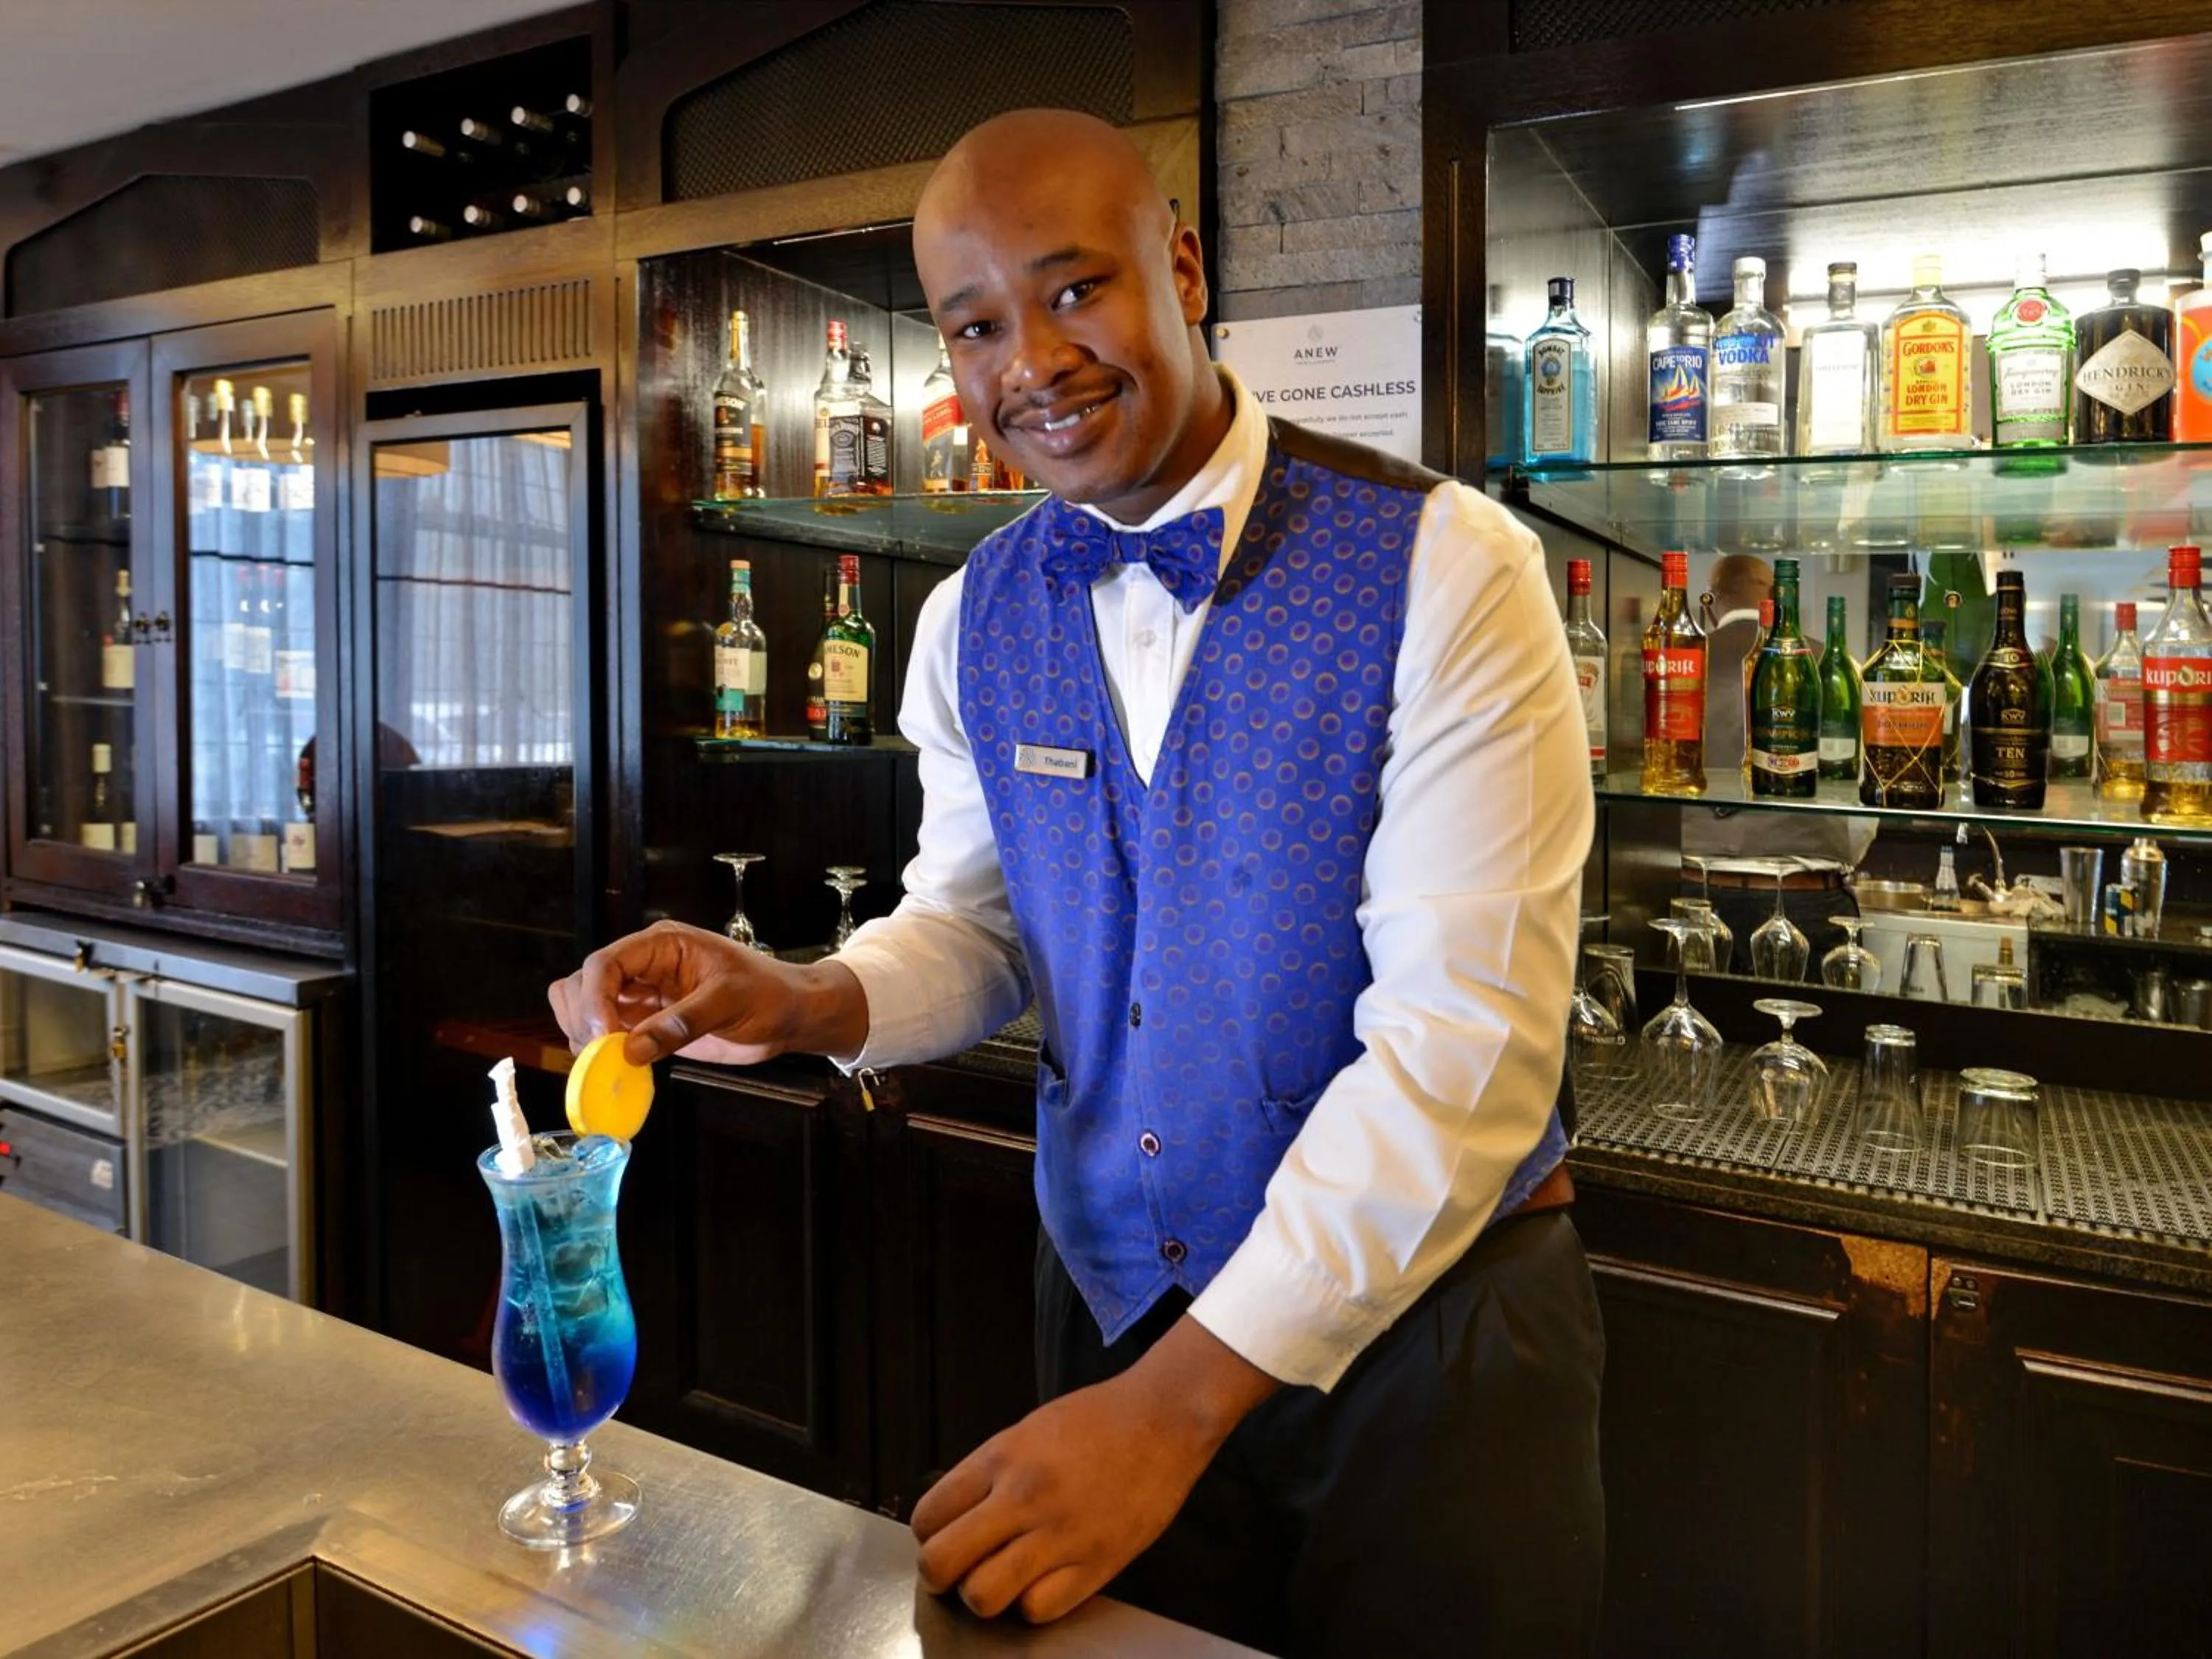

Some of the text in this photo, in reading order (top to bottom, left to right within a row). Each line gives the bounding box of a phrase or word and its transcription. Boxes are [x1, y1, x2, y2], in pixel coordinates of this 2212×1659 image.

[1293, 347, 1338, 358] ANEW
[1719, 349, 1770, 365] VODKA
[1652, 356, 1676, 370] CAPE
[1686, 355, 1703, 369] RIO
[1280, 387, 1326, 402] GONE
[1331, 380, 1416, 398] CASHLESS
[1907, 383, 1947, 394] LONDON
[1905, 394, 1948, 406] DRY GIN
[2003, 653, 2020, 663] 10
[1995, 747, 2025, 759] TEN
